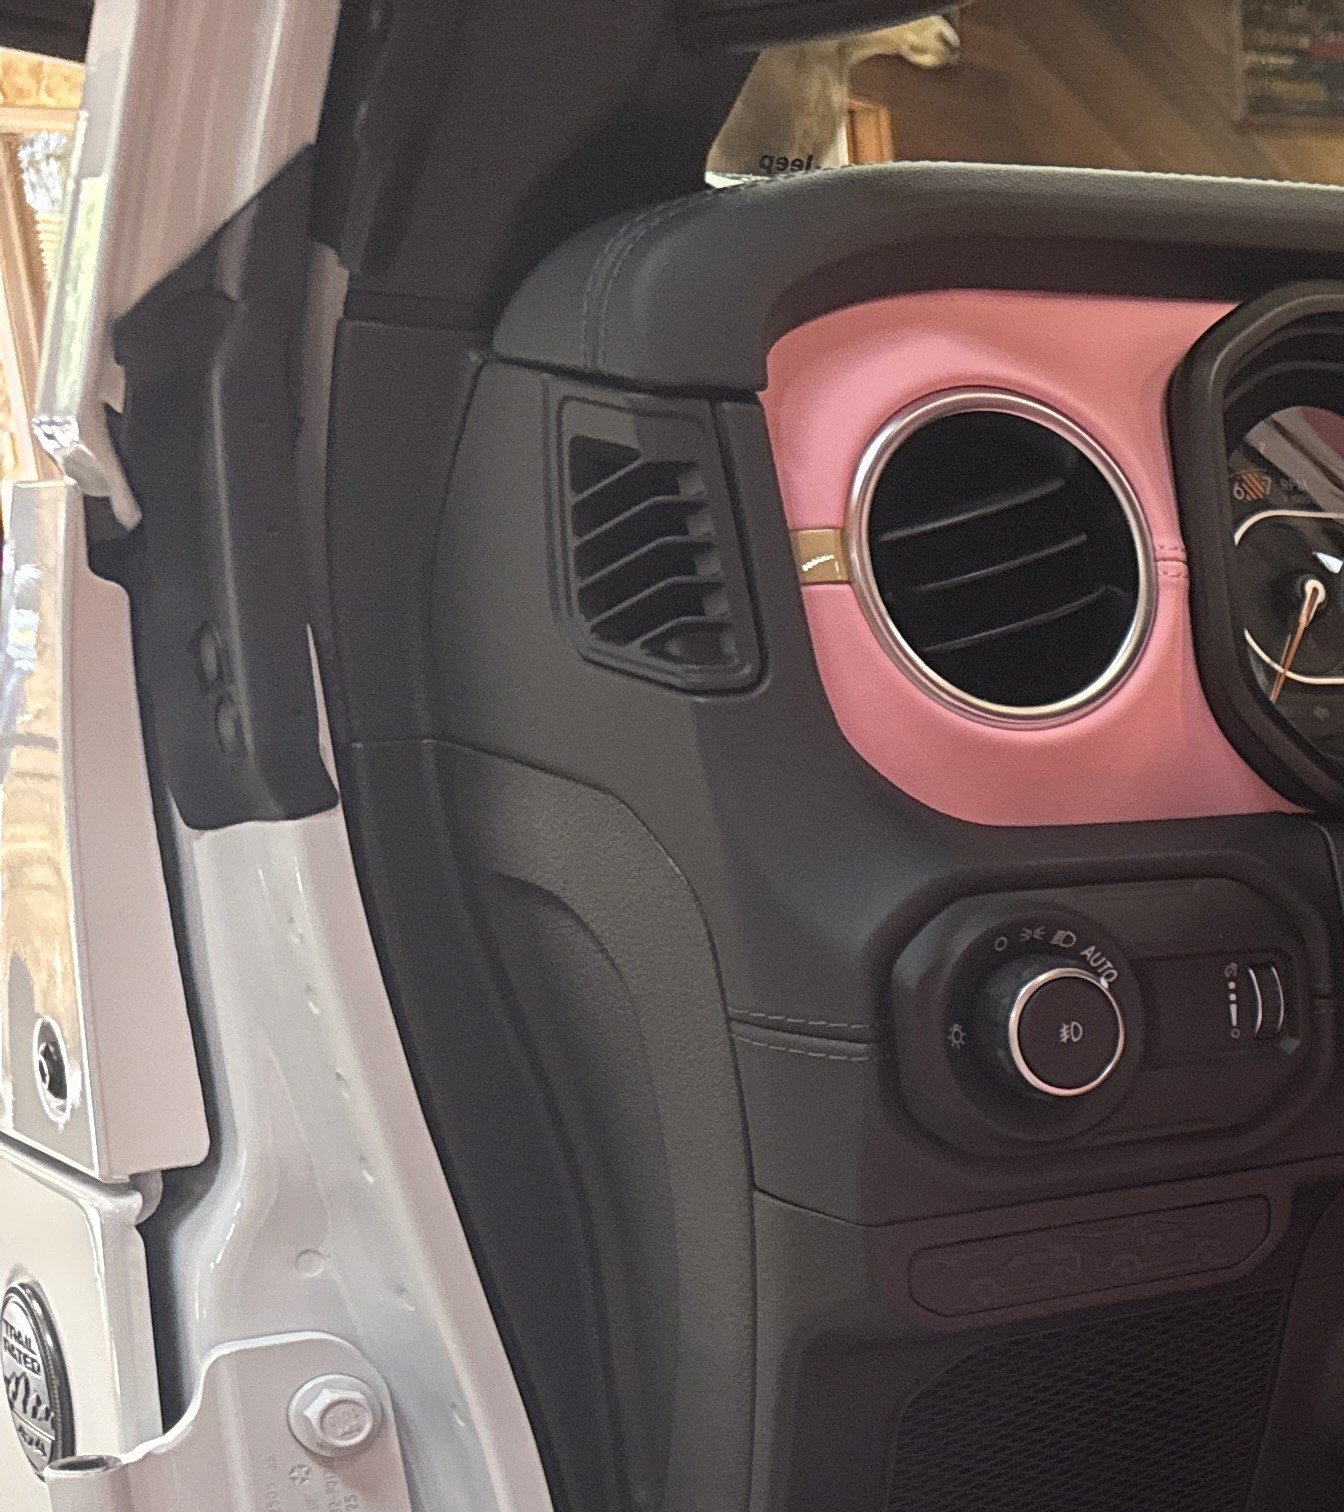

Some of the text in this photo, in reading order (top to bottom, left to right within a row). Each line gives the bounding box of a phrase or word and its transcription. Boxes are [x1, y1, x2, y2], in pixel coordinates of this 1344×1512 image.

[1233, 480, 1245, 501] 6
[1080, 945, 1118, 983] AUTO
[3, 1318, 37, 1355] TRAIL
